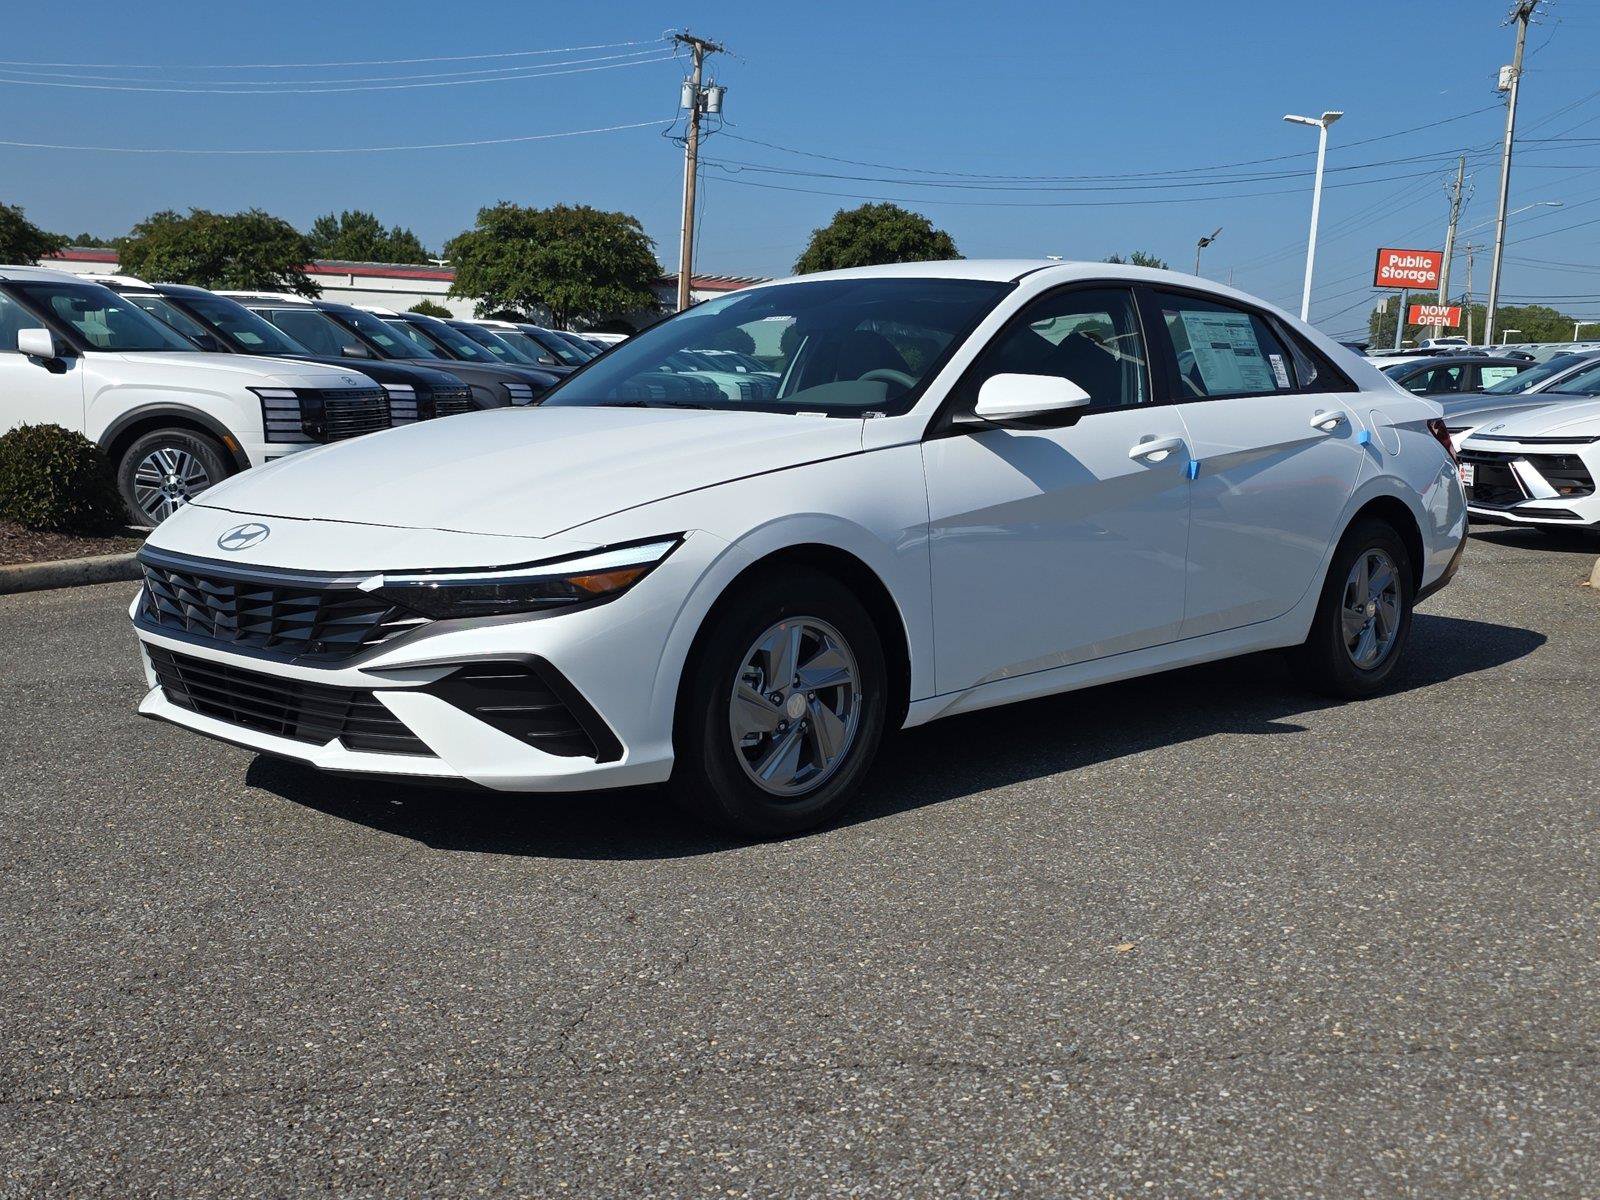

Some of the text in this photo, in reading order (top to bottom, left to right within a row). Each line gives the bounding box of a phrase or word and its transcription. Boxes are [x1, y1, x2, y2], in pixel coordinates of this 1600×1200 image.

[1389, 254, 1433, 268] Public
[1381, 266, 1436, 283] Storage
[1420, 305, 1450, 316] NOW
[1417, 316, 1451, 326] OPEN
